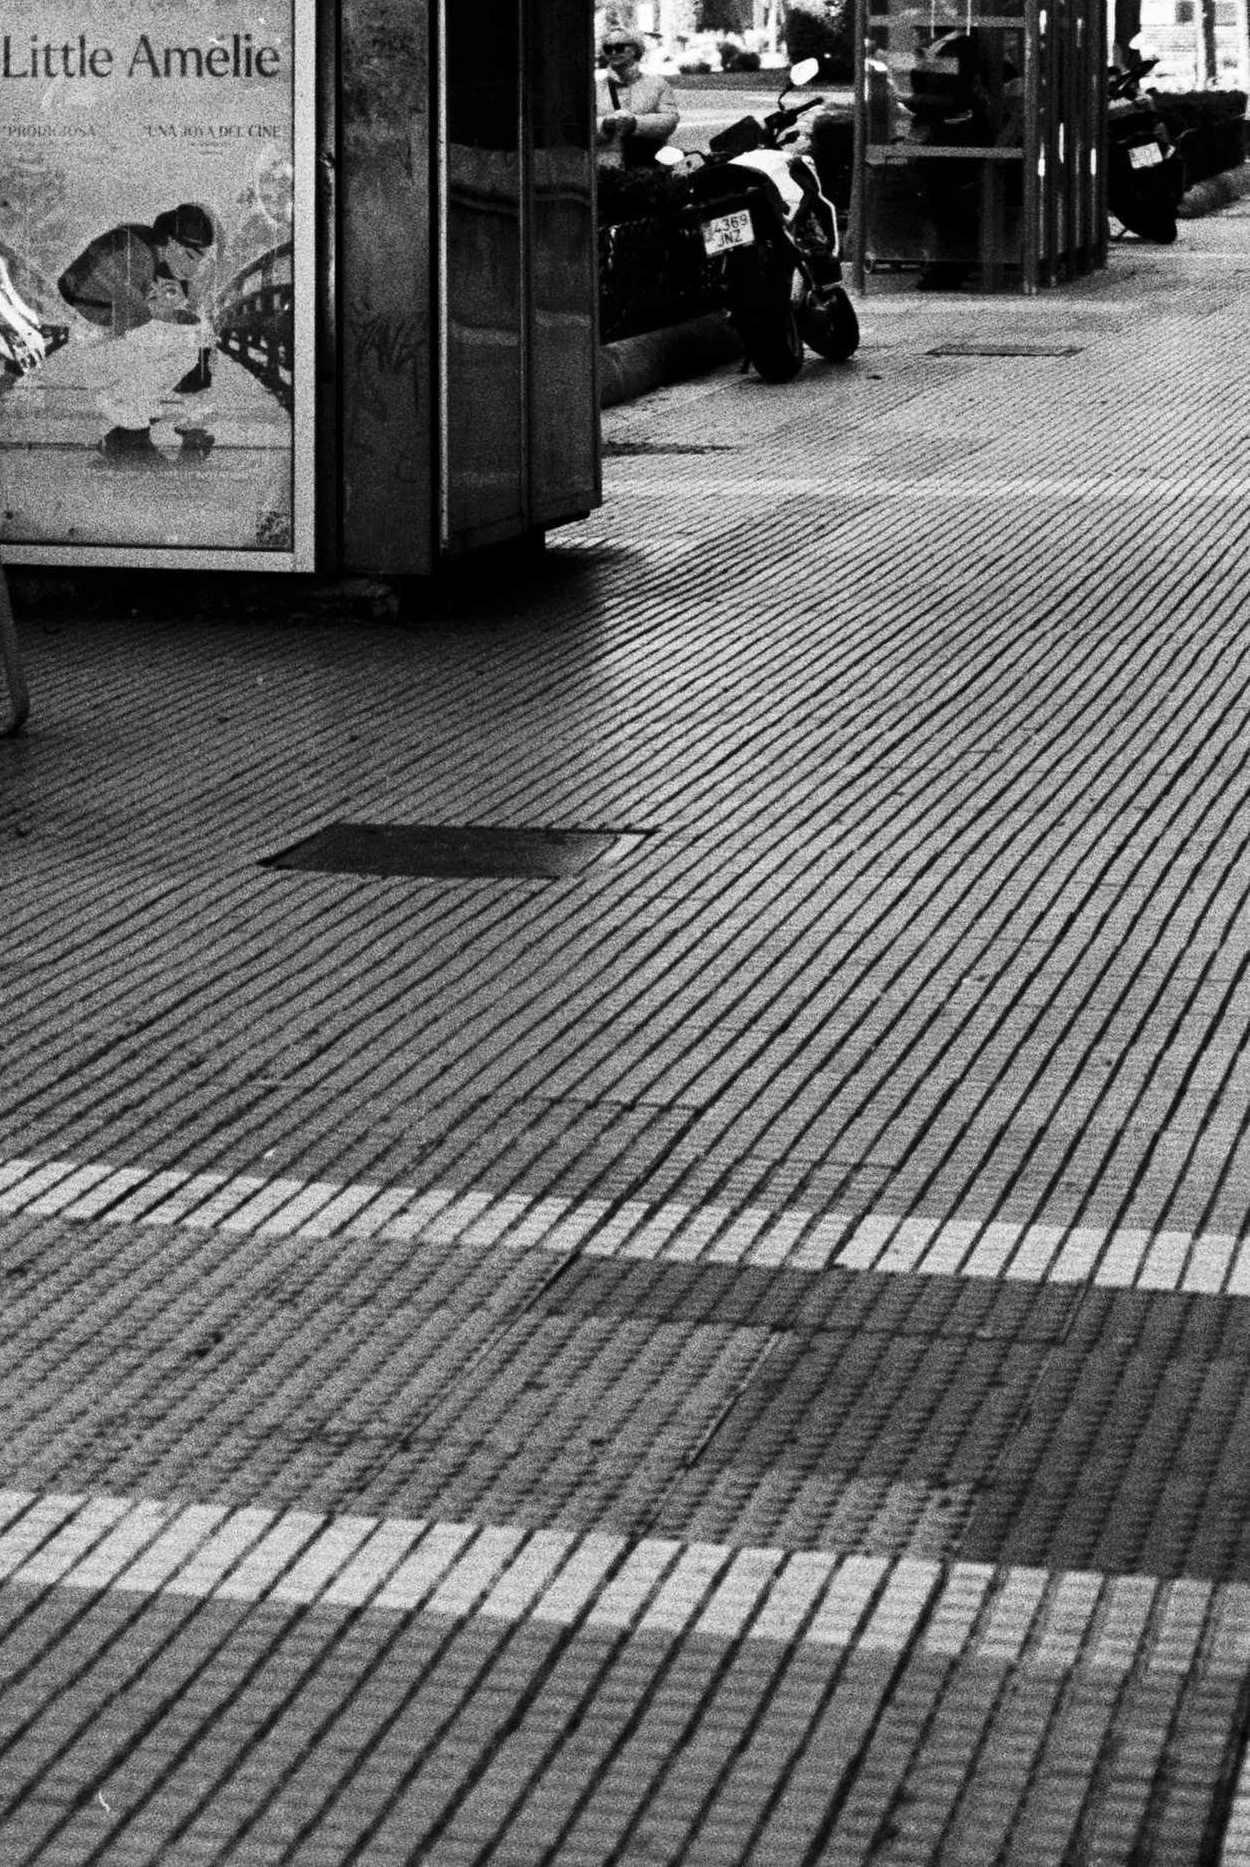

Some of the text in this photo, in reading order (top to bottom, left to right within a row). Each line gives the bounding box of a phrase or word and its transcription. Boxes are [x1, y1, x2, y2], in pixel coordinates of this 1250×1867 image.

[3, 34, 113, 79] Little
[714, 212, 748, 233] 4369
[718, 228, 743, 248] JNZ
